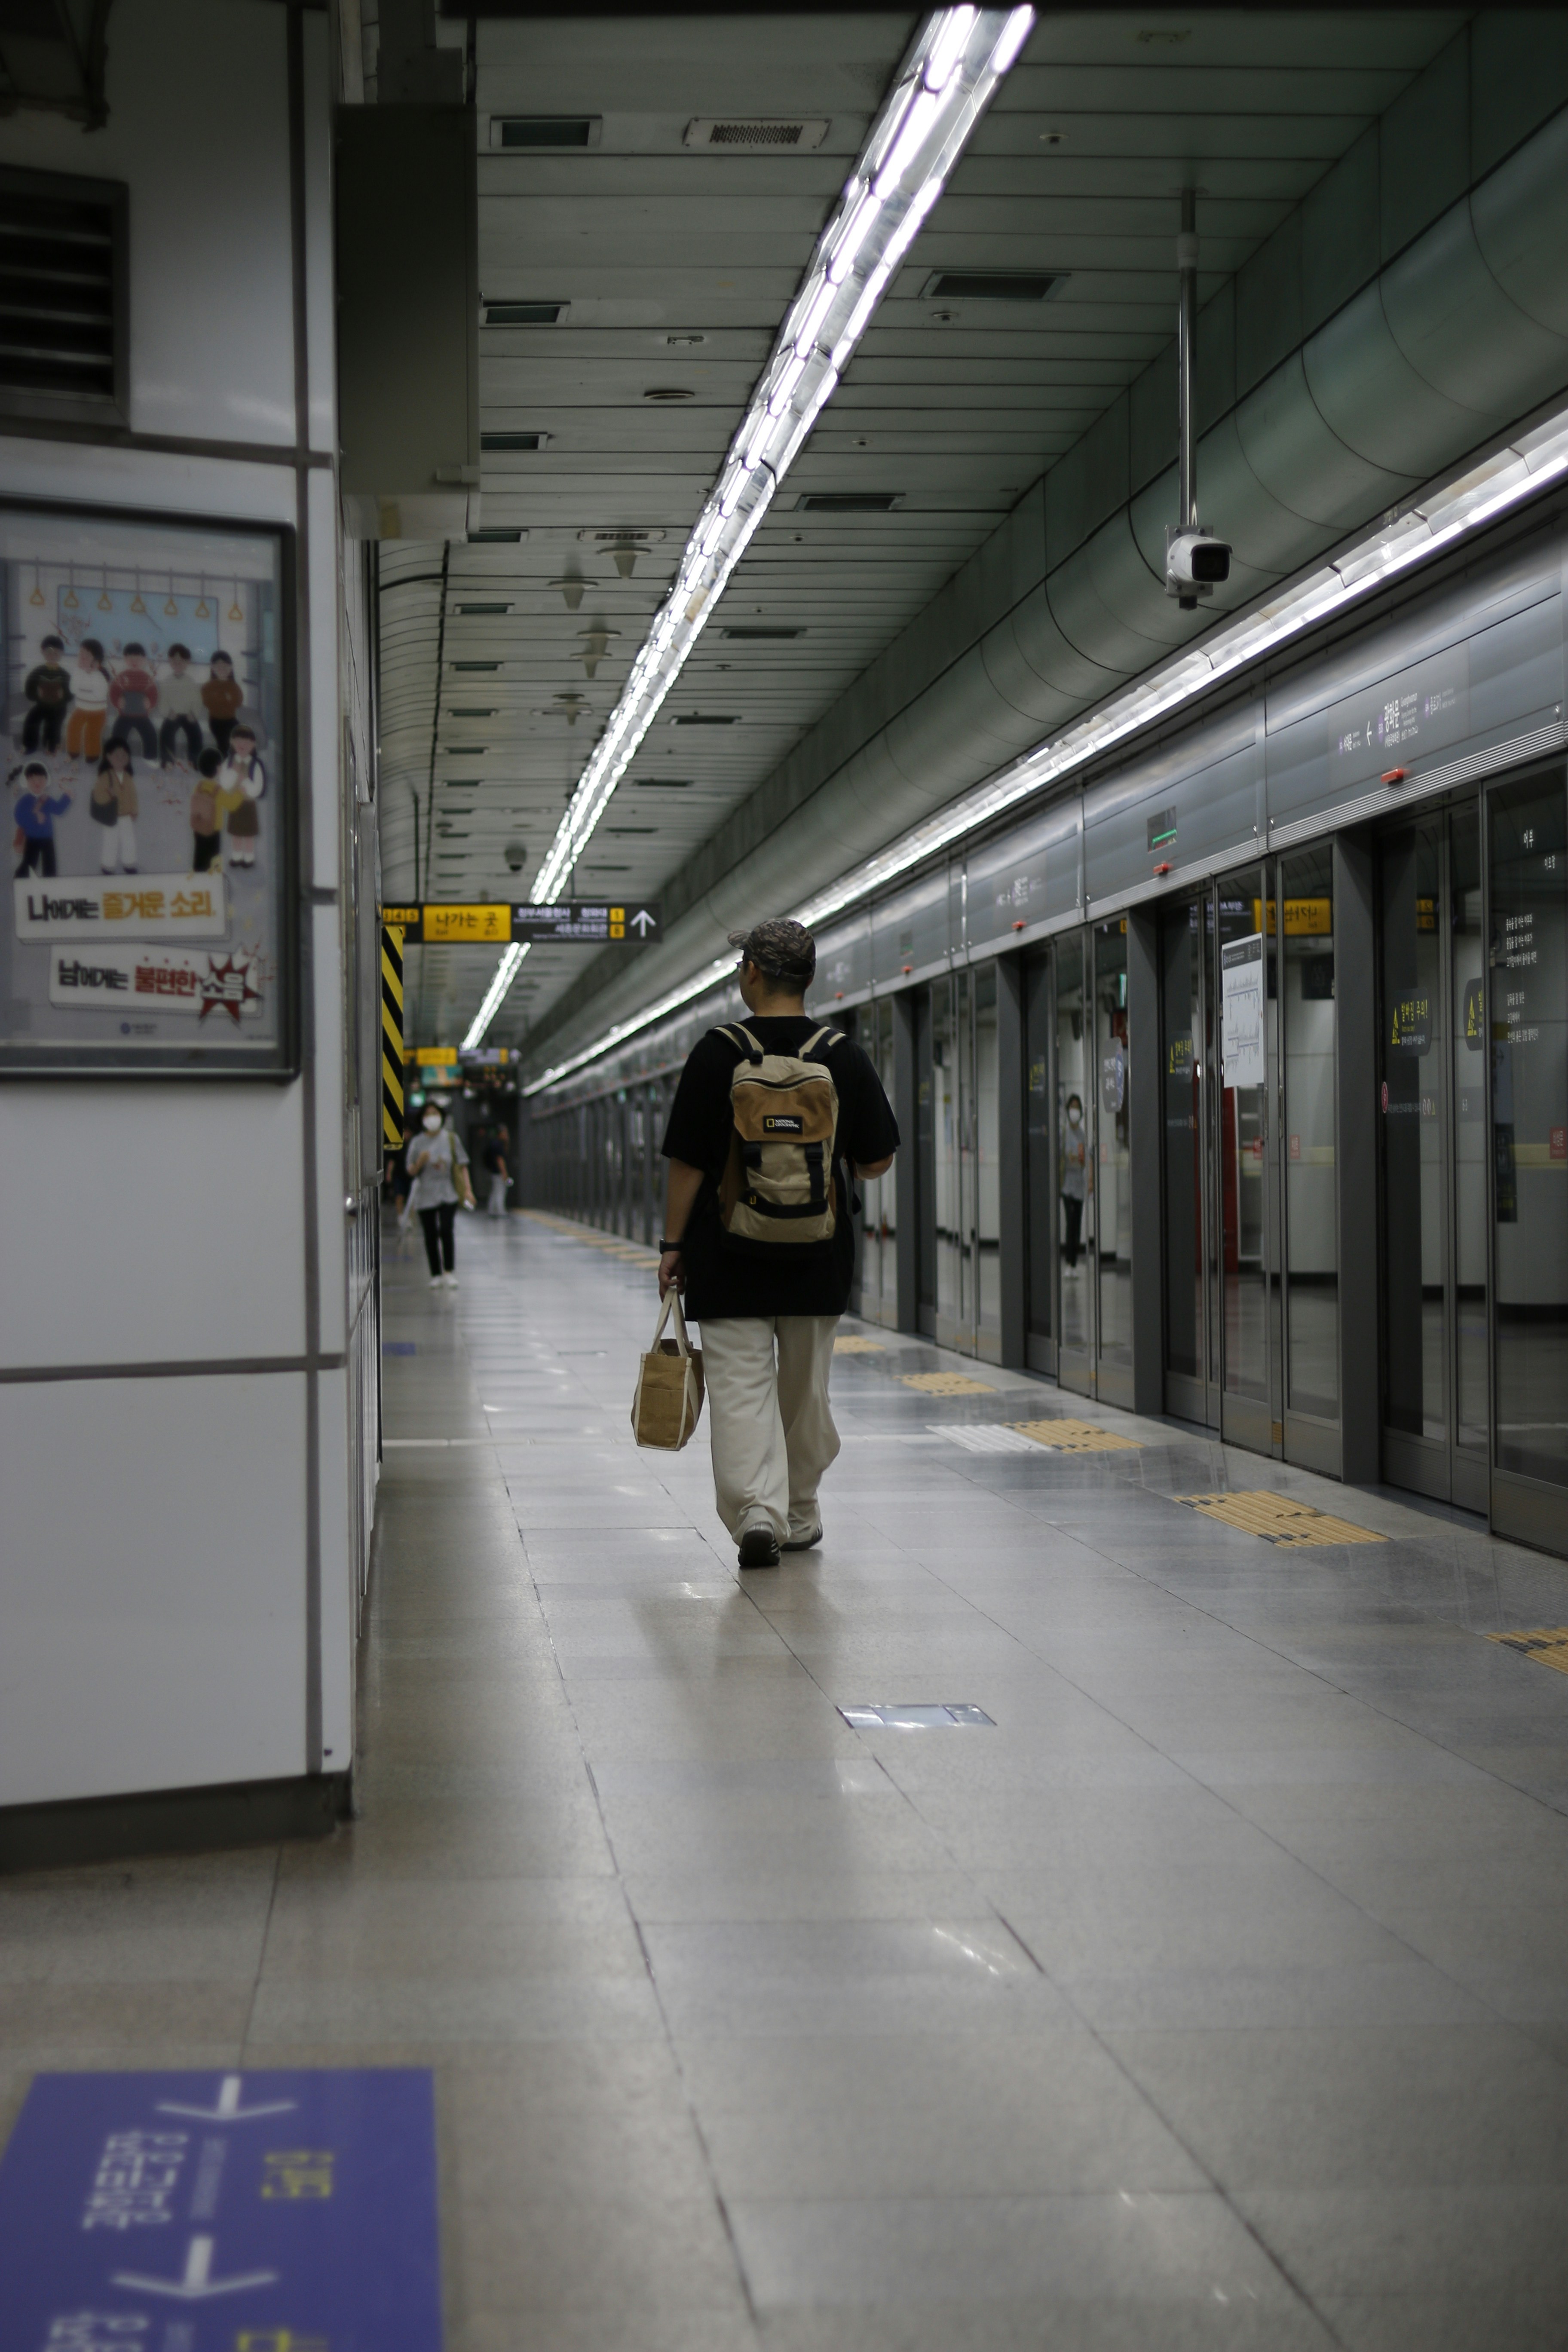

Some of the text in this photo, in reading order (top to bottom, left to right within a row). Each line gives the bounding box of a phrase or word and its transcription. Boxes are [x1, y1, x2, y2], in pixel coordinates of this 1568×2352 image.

[1384, 699, 1400, 732] 광화문
[1524, 829, 1534, 848] 어부
[28, 894, 99, 921] 나에게는
[103, 891, 165, 919] 즐거운
[436, 911, 499, 927] 나가는 곳
[58, 959, 244, 1001] 남에게는 불편한 소음
[1401, 998, 1428, 1022] 발빠짐 주의!
